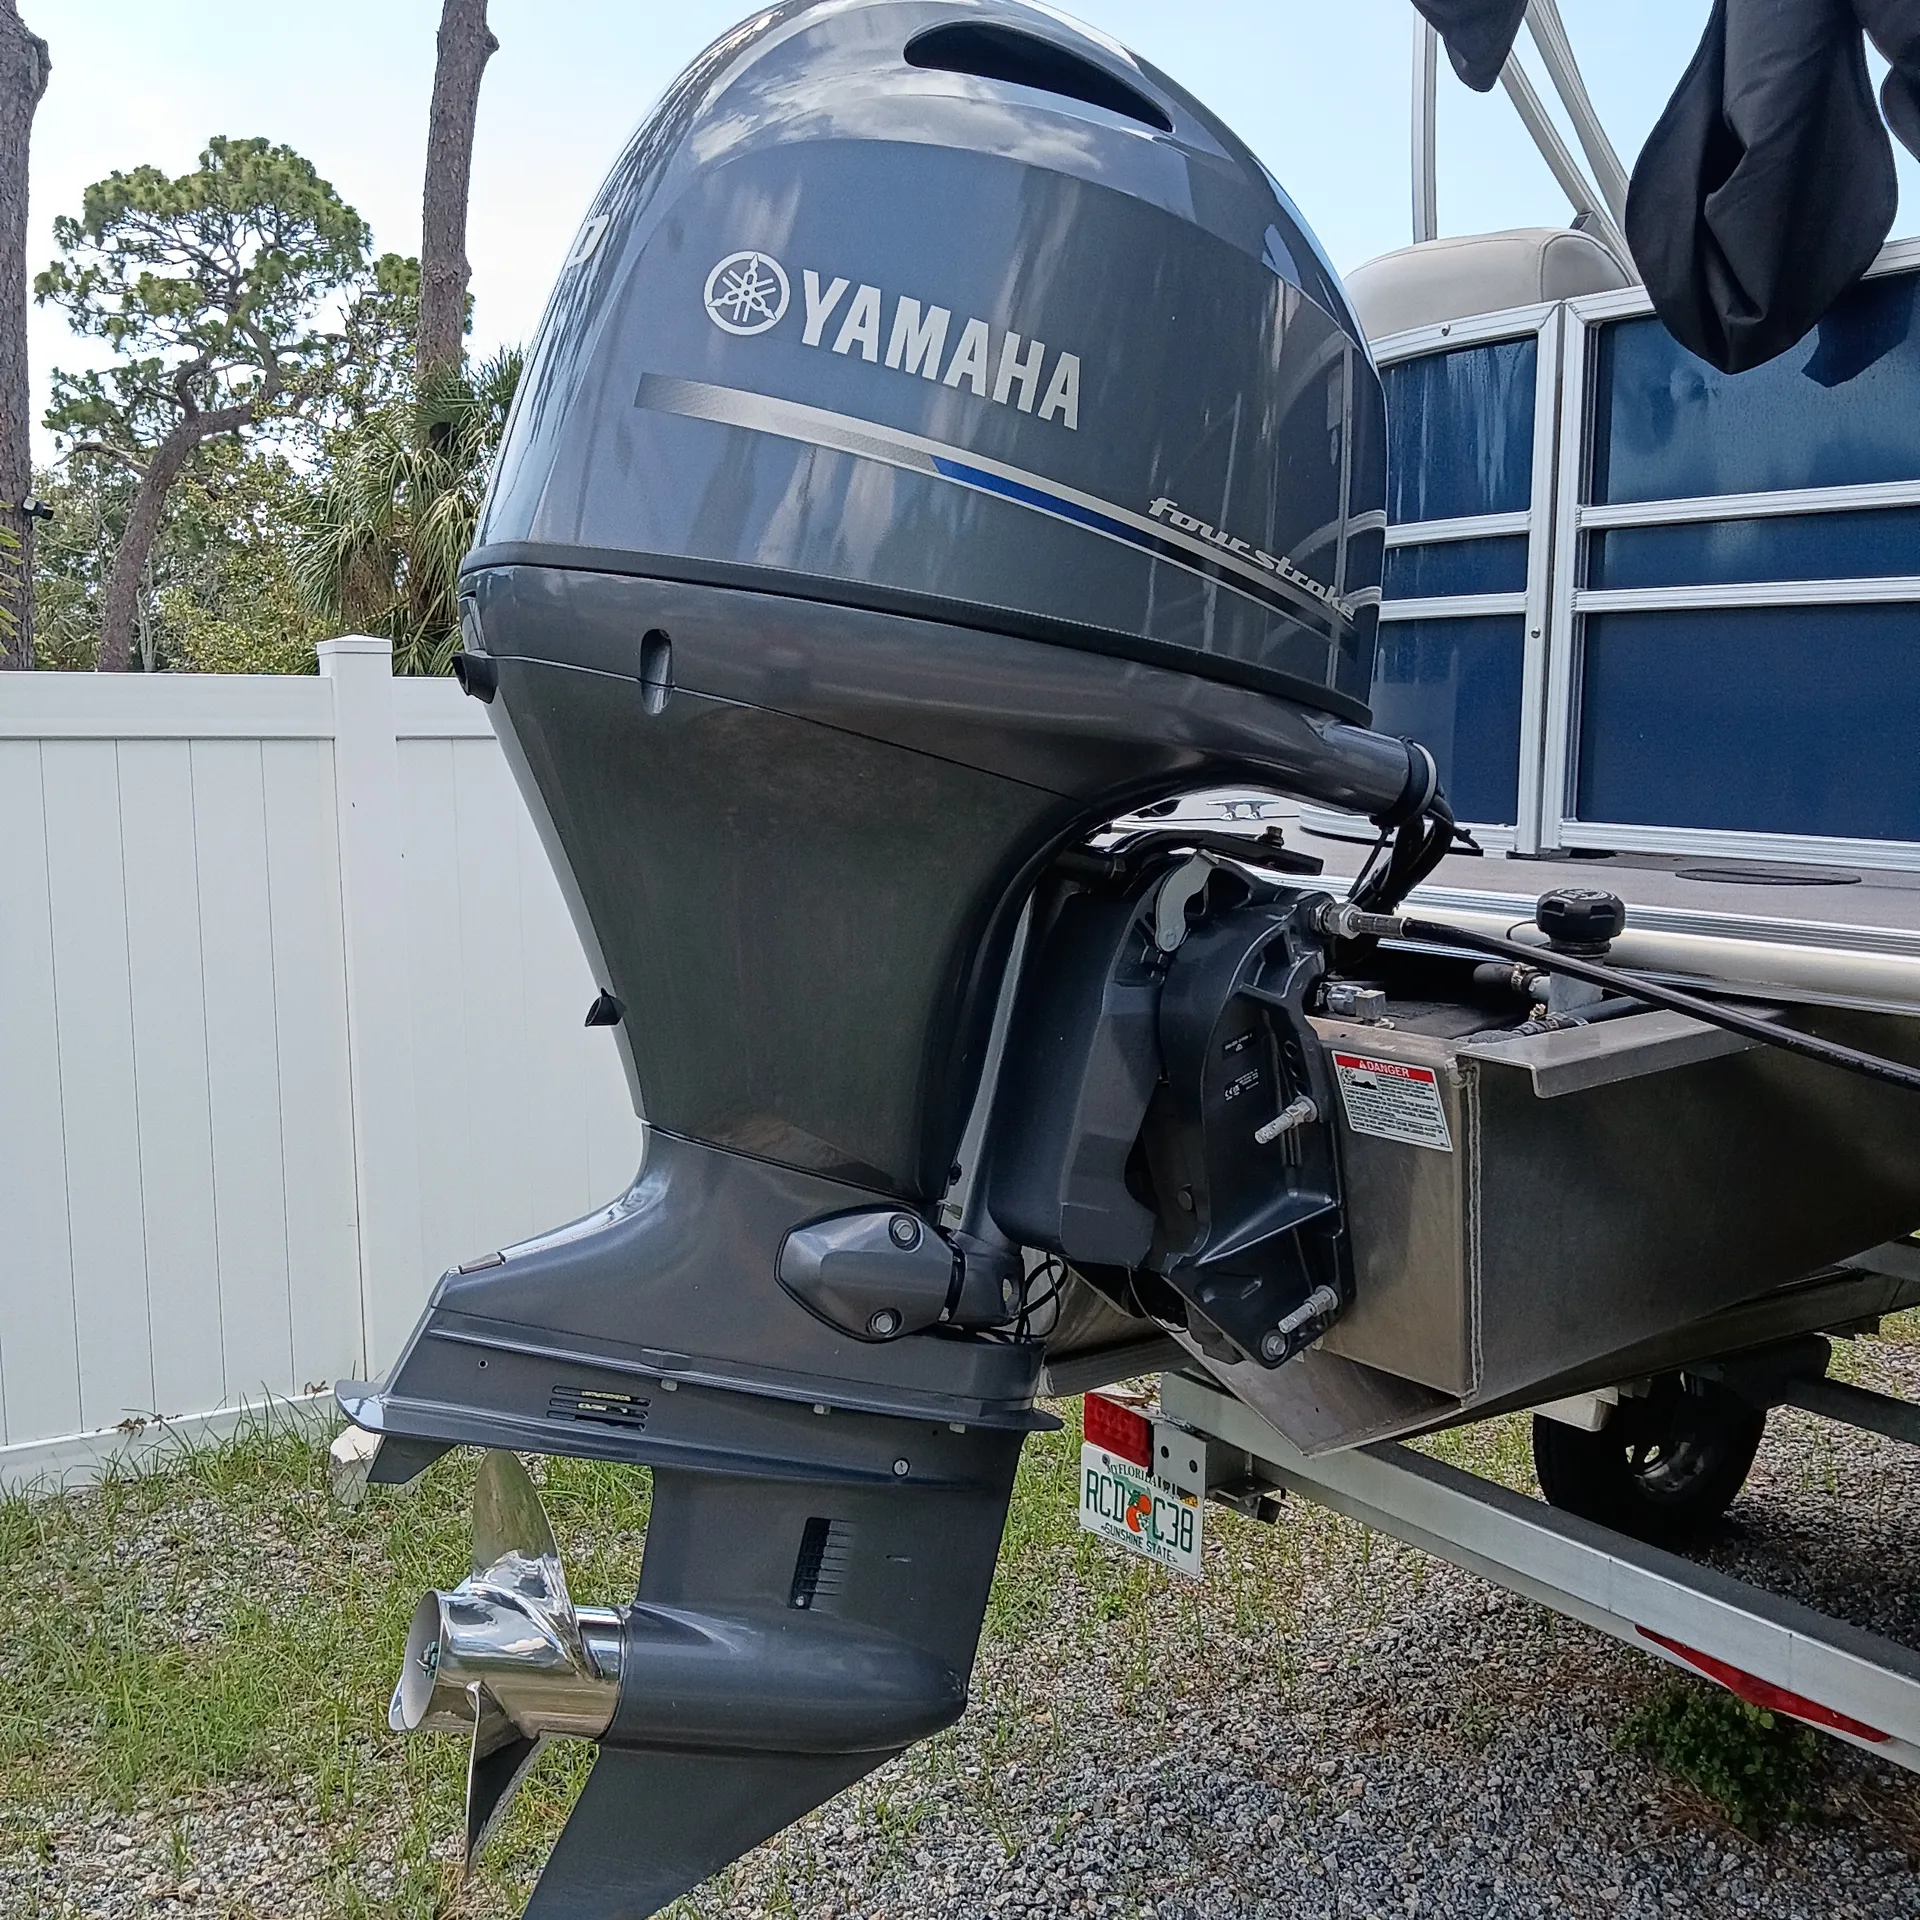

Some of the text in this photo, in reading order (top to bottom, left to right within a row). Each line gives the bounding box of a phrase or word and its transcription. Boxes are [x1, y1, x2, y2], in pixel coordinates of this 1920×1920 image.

[802, 269, 1081, 431] YAMAHA
[1366, 1061, 1410, 1078] DANGER
[1086, 1468, 1125, 1523] RCD
[1103, 1522, 1173, 1562] SUNSHINE STATE
